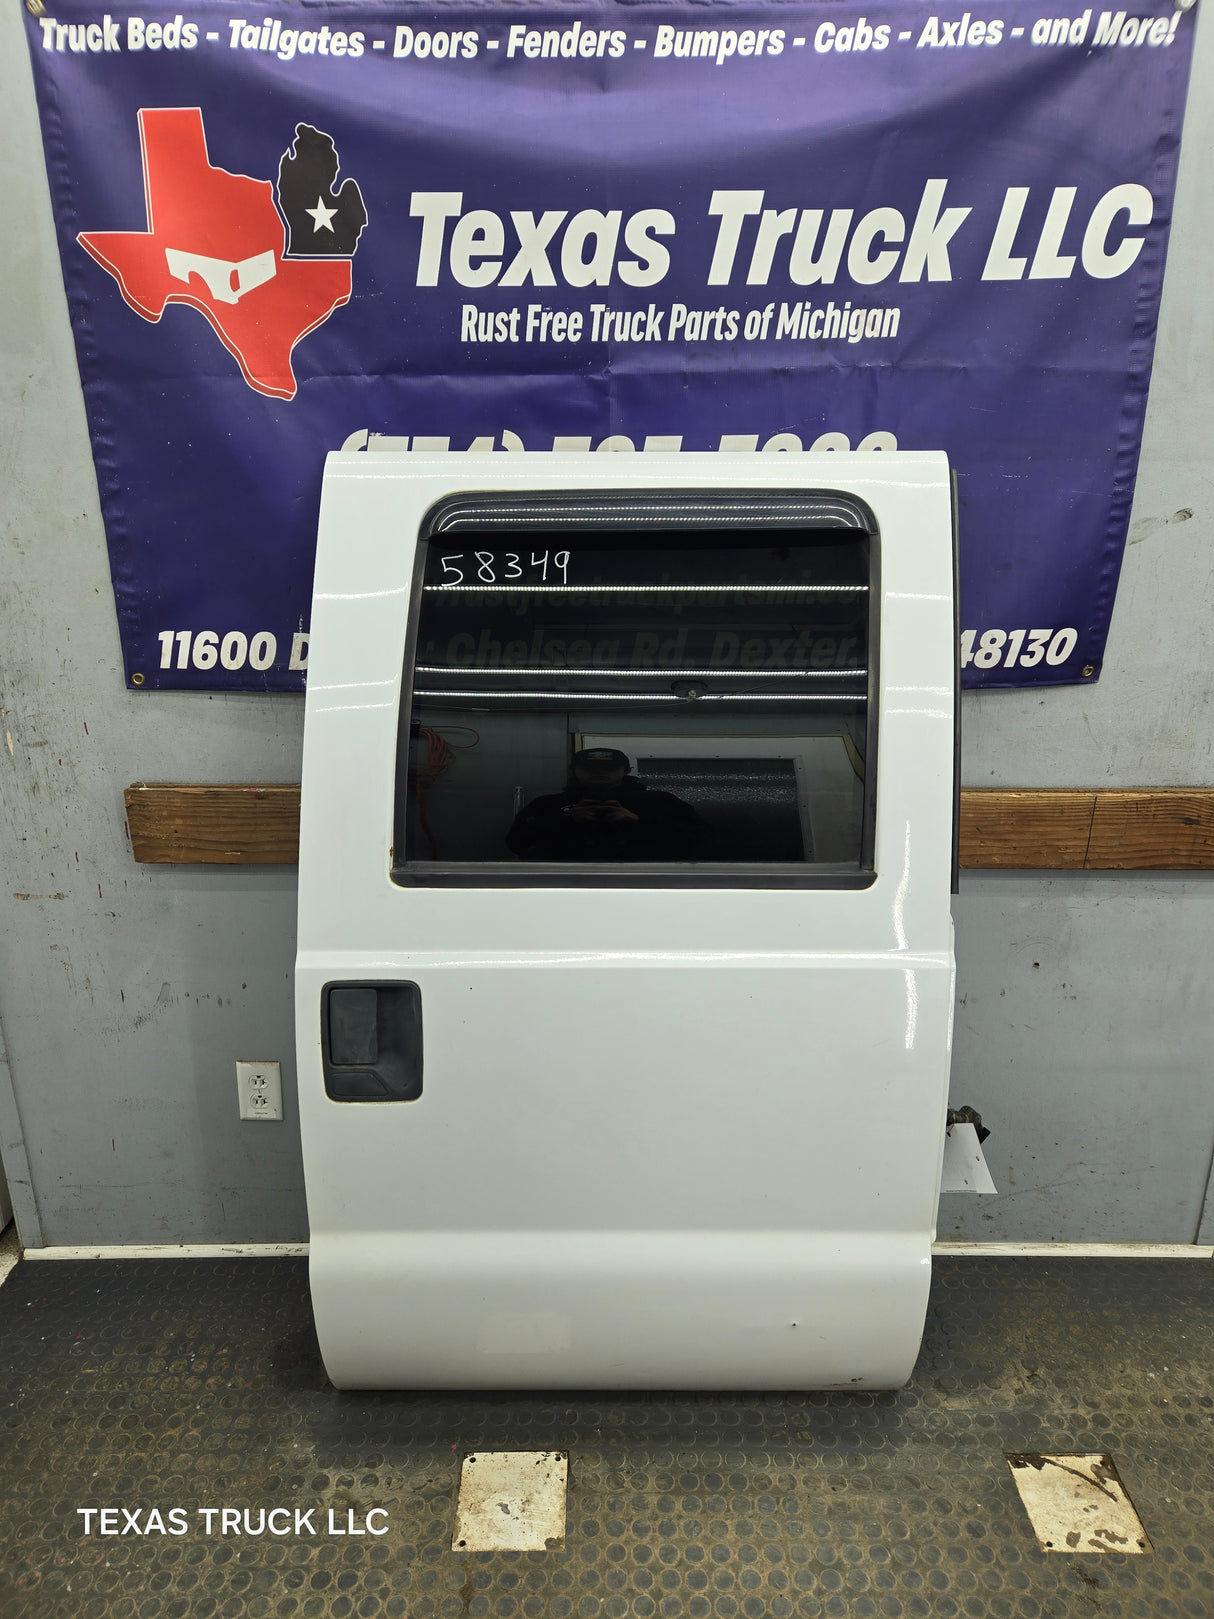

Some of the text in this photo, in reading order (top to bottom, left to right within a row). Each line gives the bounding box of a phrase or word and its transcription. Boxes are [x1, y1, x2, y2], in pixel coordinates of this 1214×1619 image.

[40, 16, 121, 53] Truck
[127, 15, 200, 50] Beds
[228, 18, 366, 61] Tailgates
[392, 26, 479, 59] Doors
[506, 21, 627, 59] Fenders
[653, 25, 786, 66] Bumpers
[813, 18, 892, 54] Cabs
[915, 13, 1005, 49] Axles
[1031, 9, 1092, 46] and
[1091, 11, 1182, 46] More!
[409, 178, 1155, 288] Texas Truck LLC
[460, 301, 901, 344] Rust Free Truck Parts of Michigan
[440, 550, 571, 587] 58349
[158, 630, 277, 671] 11600
[445, 629, 620, 667] Chelsea
